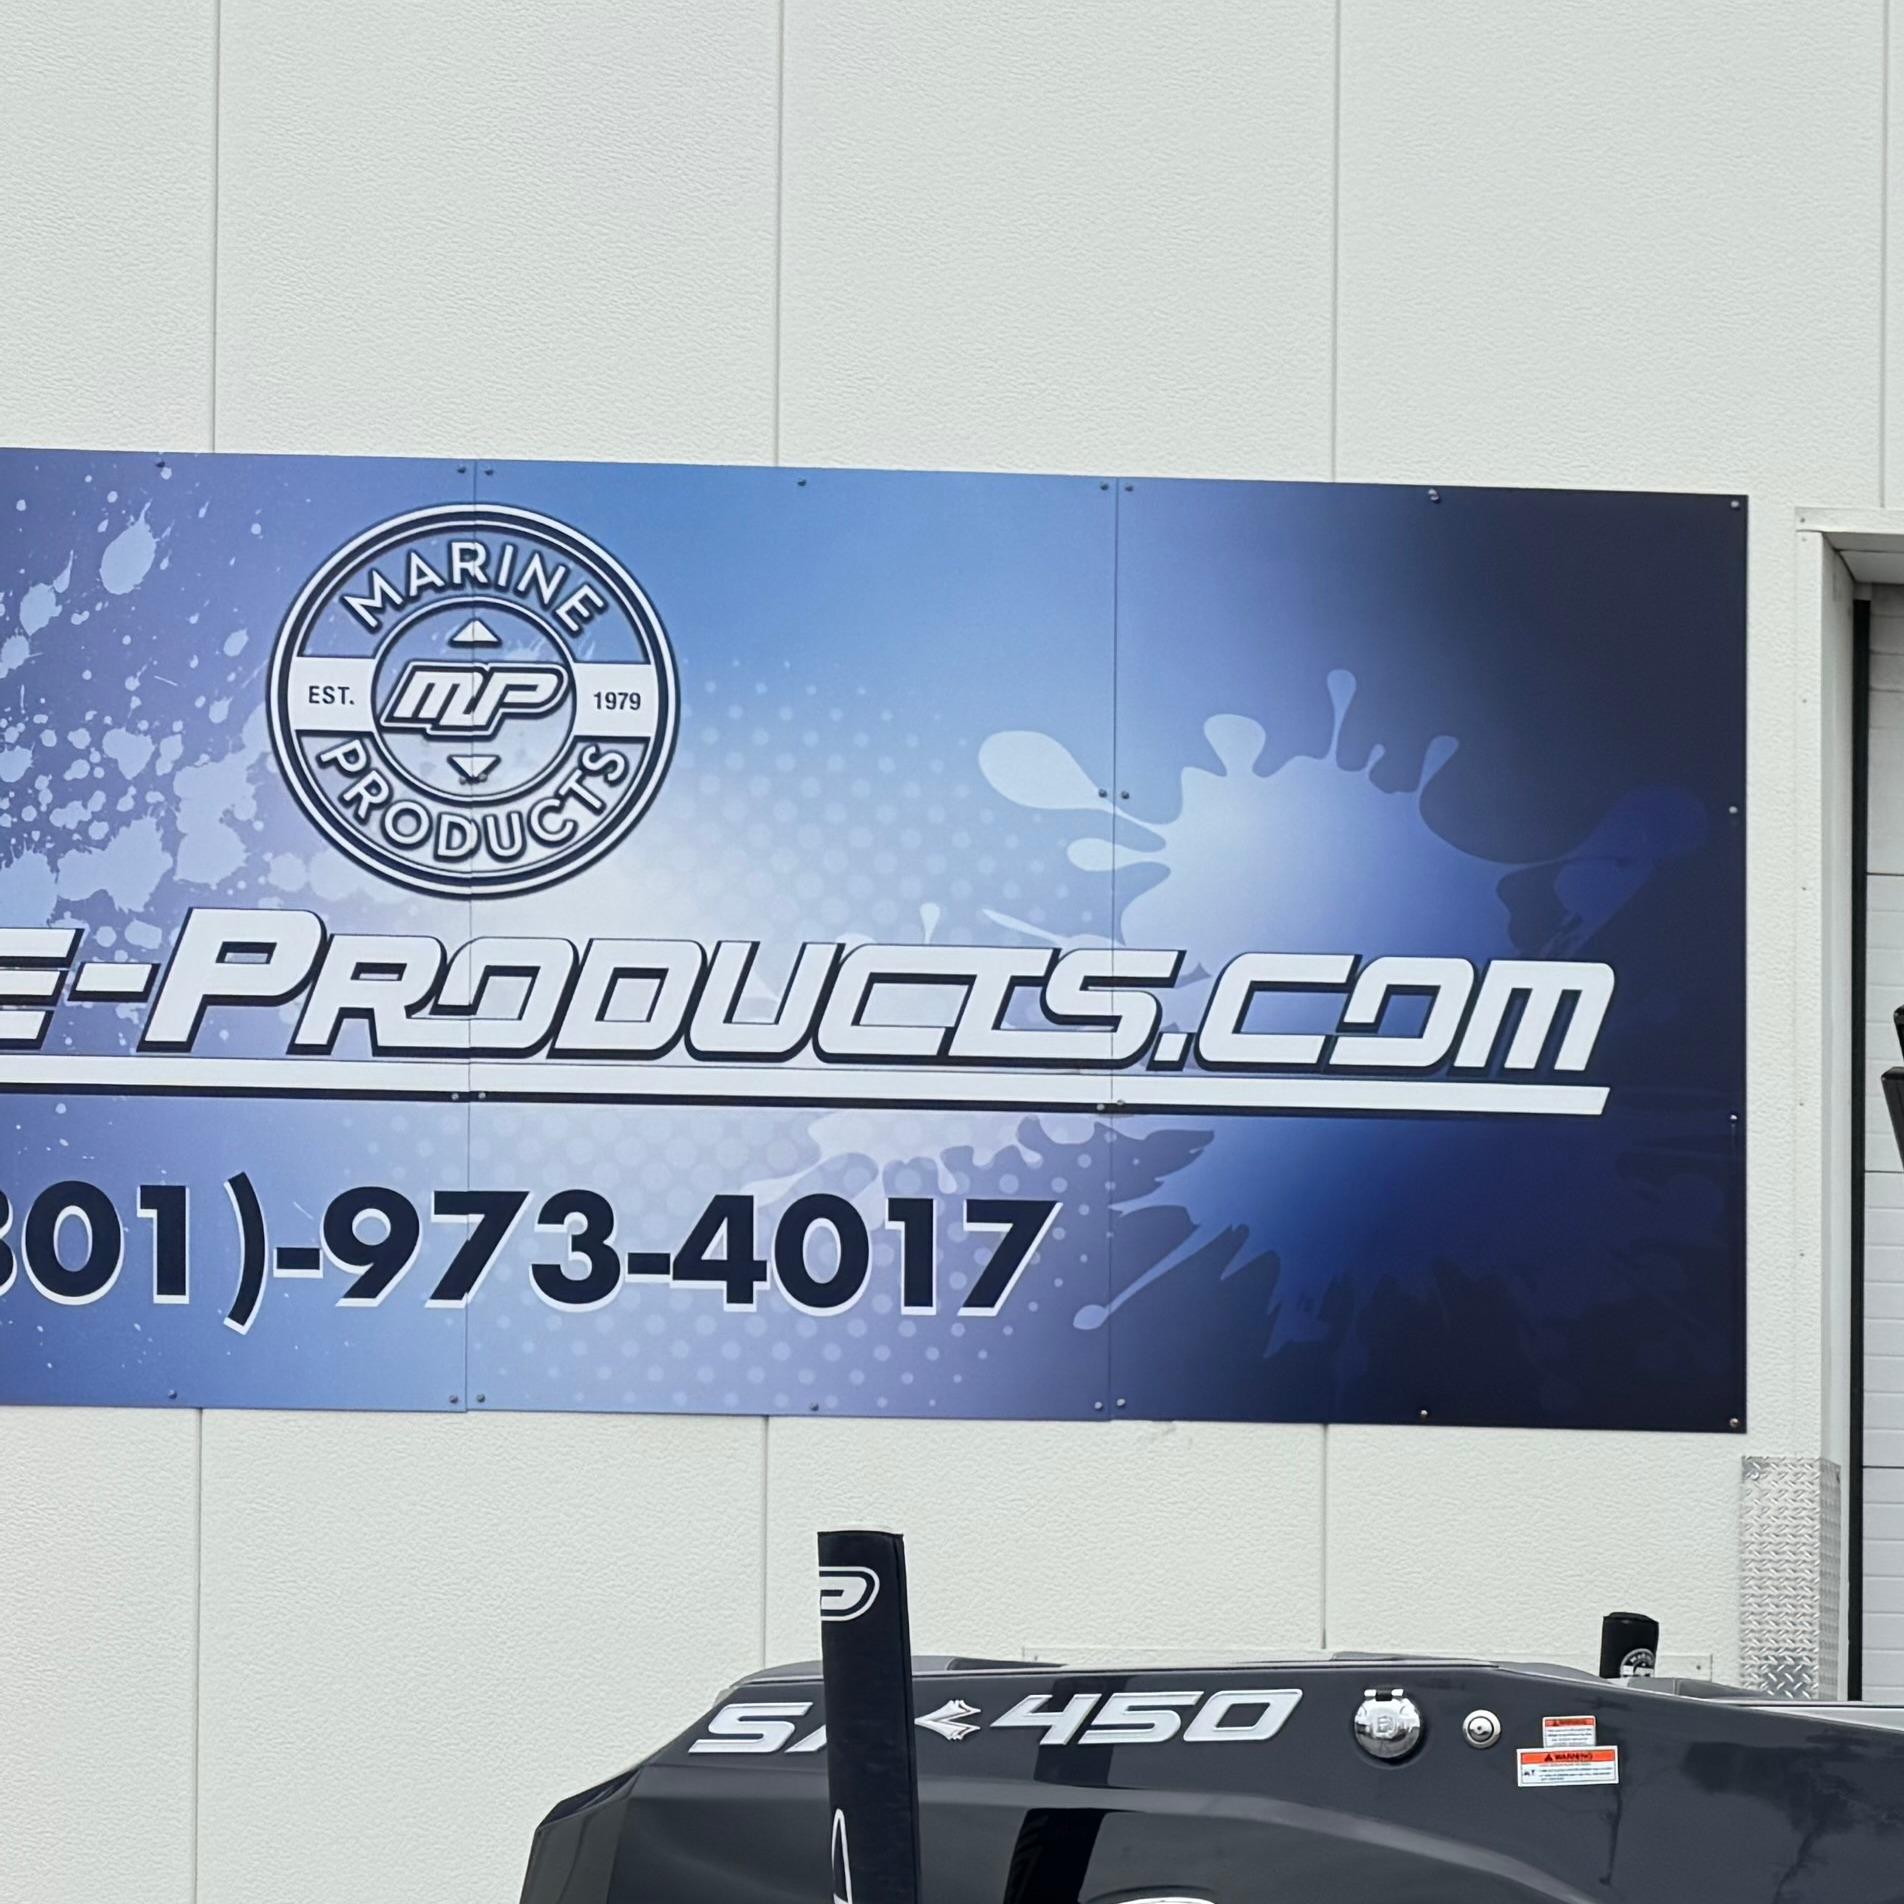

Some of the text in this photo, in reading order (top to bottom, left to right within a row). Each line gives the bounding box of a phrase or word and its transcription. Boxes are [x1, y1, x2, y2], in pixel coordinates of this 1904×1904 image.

[343, 541, 609, 635] MARINE
[308, 685, 355, 705] EST.
[387, 666, 567, 731] MP
[593, 692, 641, 711] 1979
[320, 738, 628, 859] PRODUCTS
[0, 1170, 1063, 1335] 01)-973-4017
